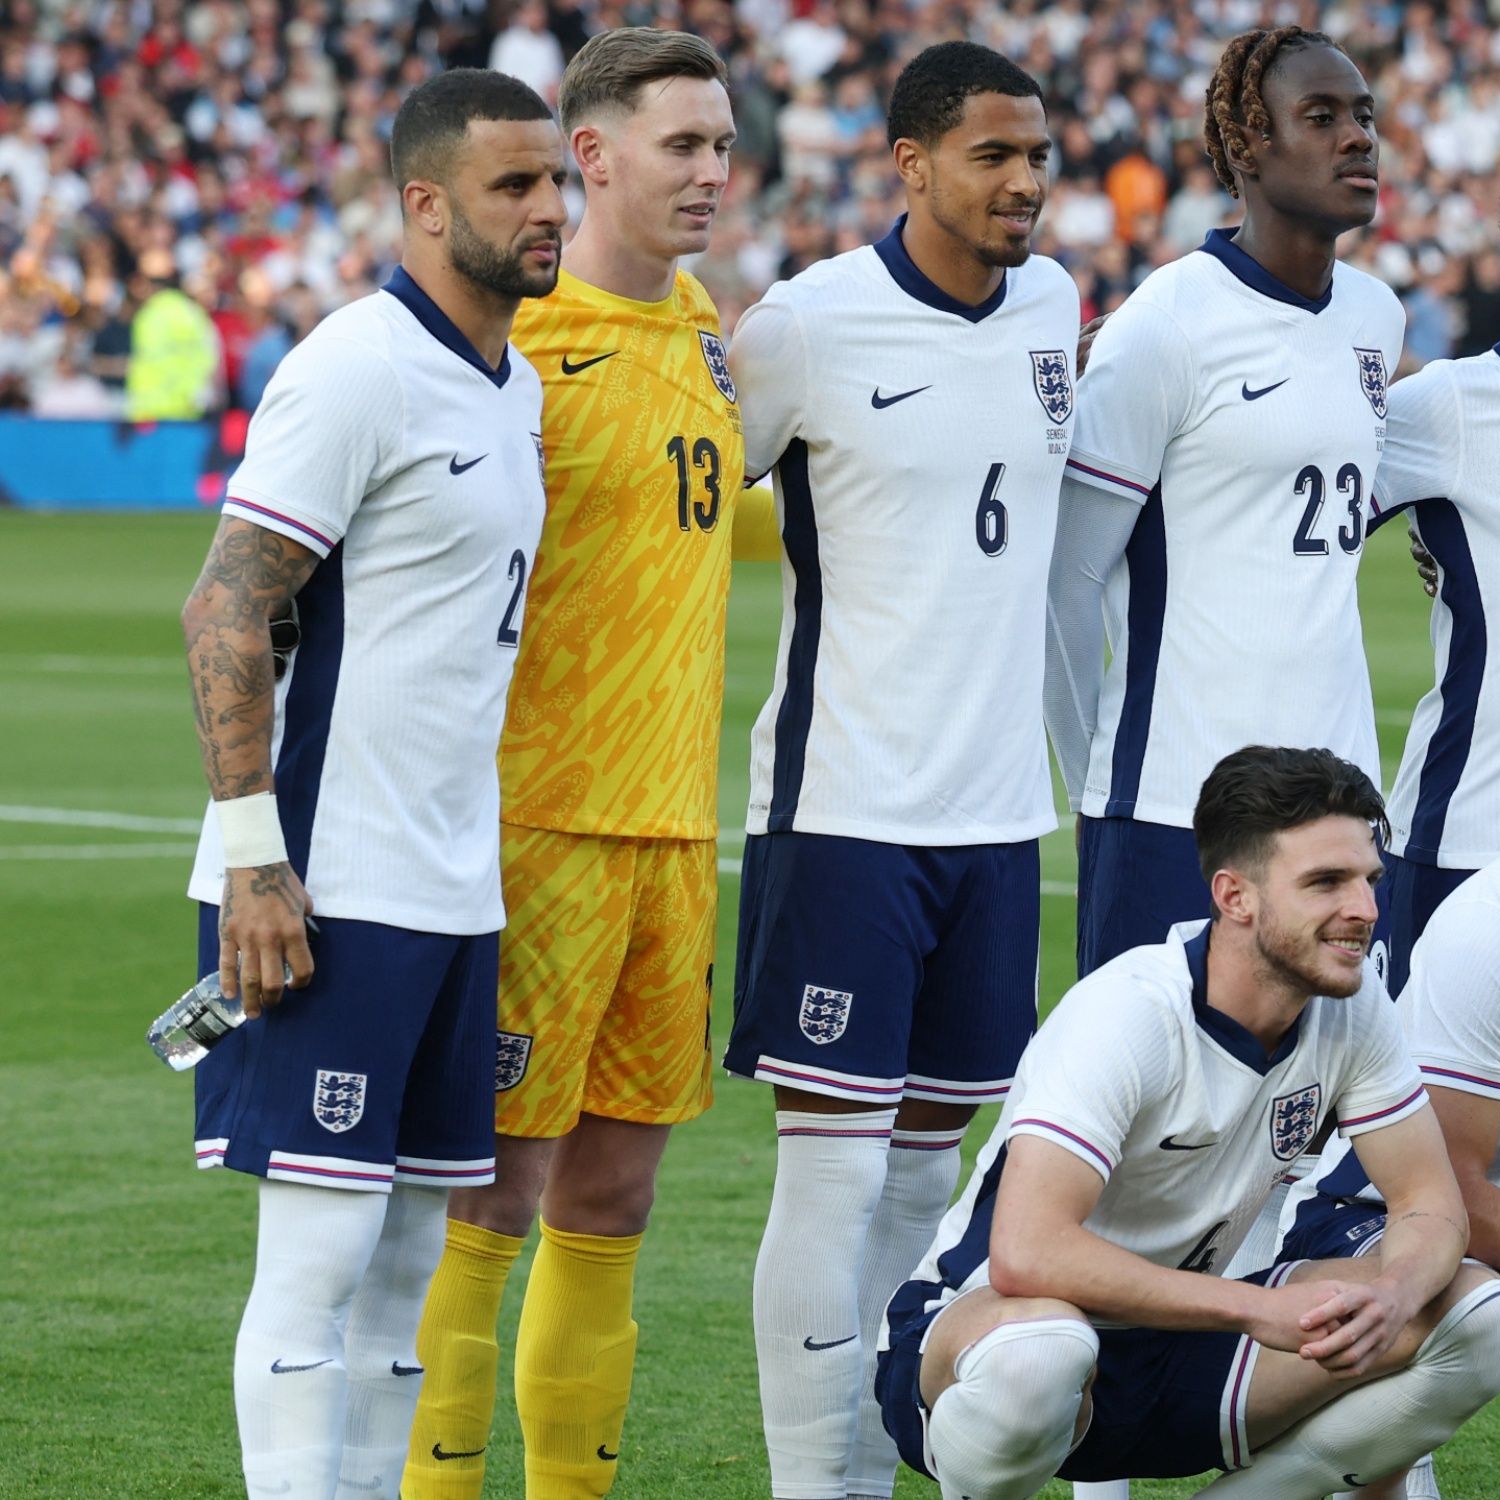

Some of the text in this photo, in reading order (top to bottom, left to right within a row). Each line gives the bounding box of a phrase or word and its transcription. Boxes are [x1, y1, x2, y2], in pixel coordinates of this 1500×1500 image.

[667, 436, 721, 533] 13
[976, 462, 1008, 557] 6
[1293, 463, 1364, 556] 23
[497, 549, 526, 648] 2
